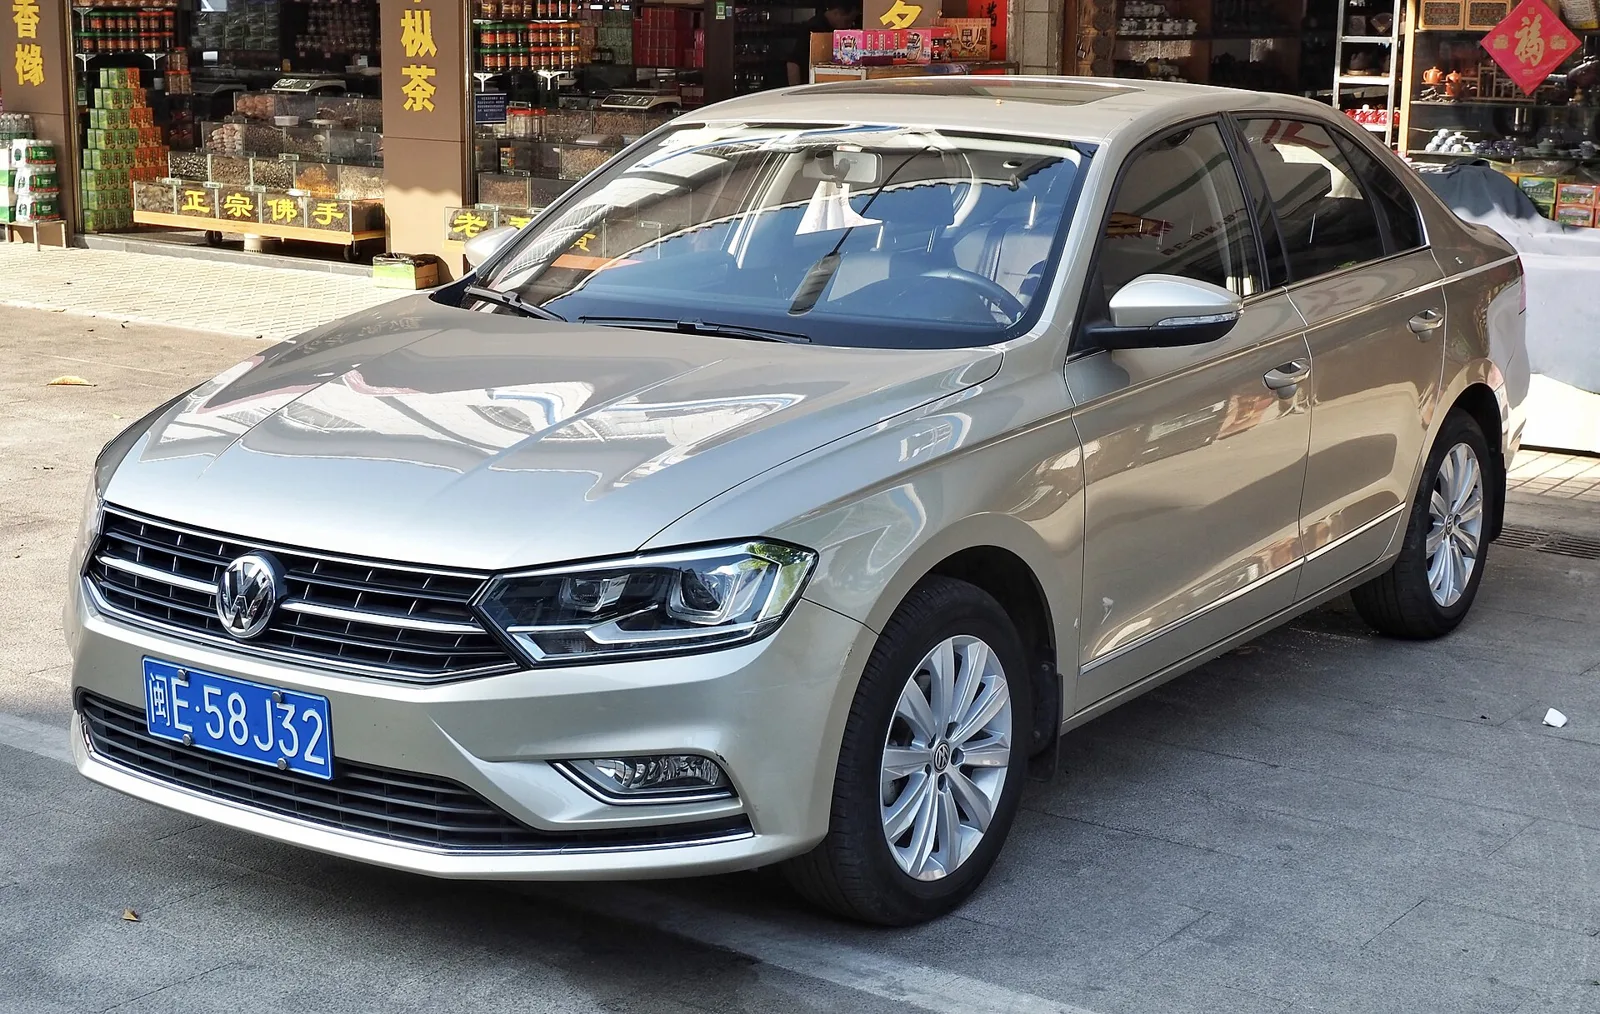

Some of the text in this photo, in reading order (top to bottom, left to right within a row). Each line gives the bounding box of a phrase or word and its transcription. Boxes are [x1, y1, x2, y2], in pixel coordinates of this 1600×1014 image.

[401, 0, 437, 112] 枞茶
[1514, 13, 1545, 66] 福
[181, 190, 344, 225] 正宗佛手
